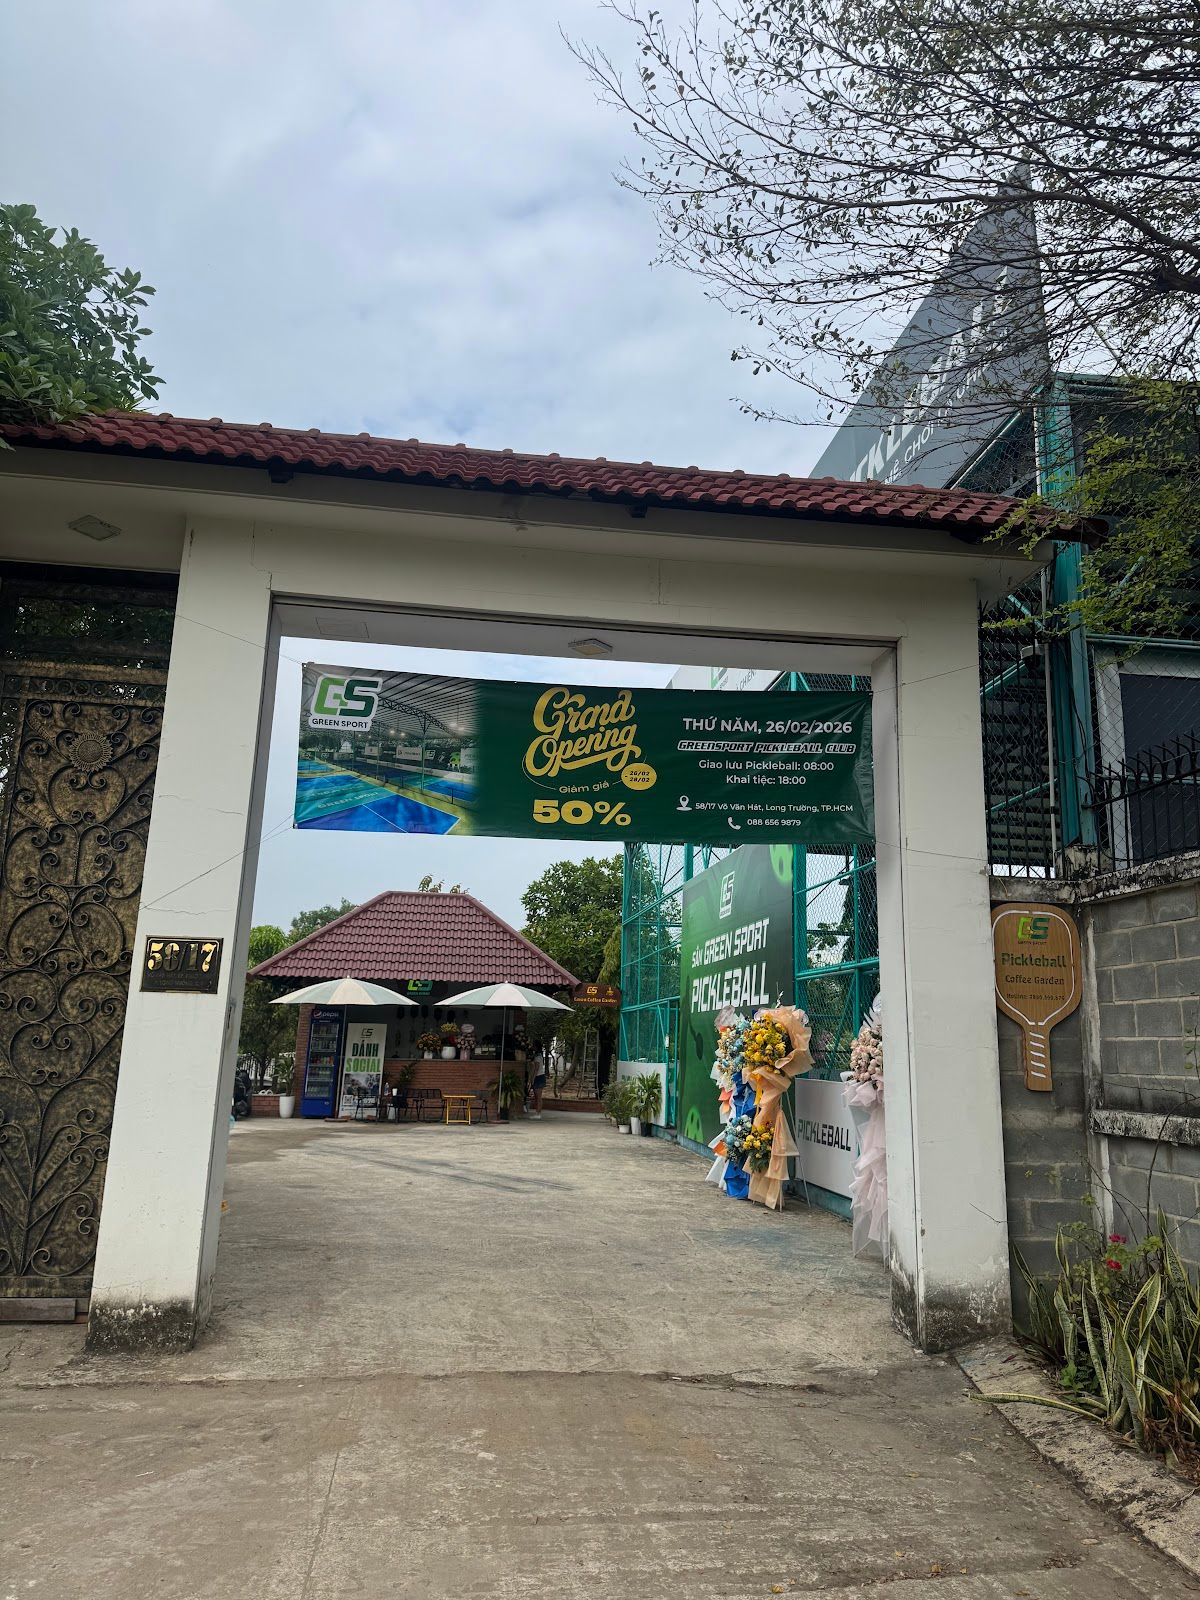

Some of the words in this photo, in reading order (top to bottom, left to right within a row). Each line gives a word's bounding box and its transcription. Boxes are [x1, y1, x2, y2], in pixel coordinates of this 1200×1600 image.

[533, 686, 636, 741] Grand
[312, 718, 340, 727] GREEN
[341, 720, 368, 729] SPORT
[683, 716, 717, 731] THỨ
[720, 717, 762, 734] NĂM,
[765, 720, 852, 734] 26/02/2026
[525, 723, 642, 778] Opening
[677, 740, 754, 752] GREENSPORT
[753, 741, 823, 754] PICKLEBALL
[824, 743, 857, 755] CLUB
[698, 759, 723, 770] Giao
[725, 760, 743, 770] lưu
[745, 760, 801, 771] Pickleball:
[803, 761, 835, 771] 08:00
[726, 775, 750, 784] Khai
[752, 775, 776, 786] tiệc:
[778, 776, 807, 785] 18:00
[532, 799, 632, 826] 50%
[695, 802, 716, 811] 58/17
[765, 804, 787, 813] Long
[747, 818, 763, 826] 088
[781, 819, 802, 827] 9879
[703, 930, 733, 966] GREEN
[733, 918, 770, 957] SPORT
[1001, 952, 1067, 968] Pickleball
[1005, 974, 1032, 984] Coffee
[1034, 976, 1065, 985] Garden
[691, 961, 770, 1014] PICKLEBALL
[345, 1058, 381, 1073] SOCIAL
[798, 1118, 851, 1152] PICKLEBALL
